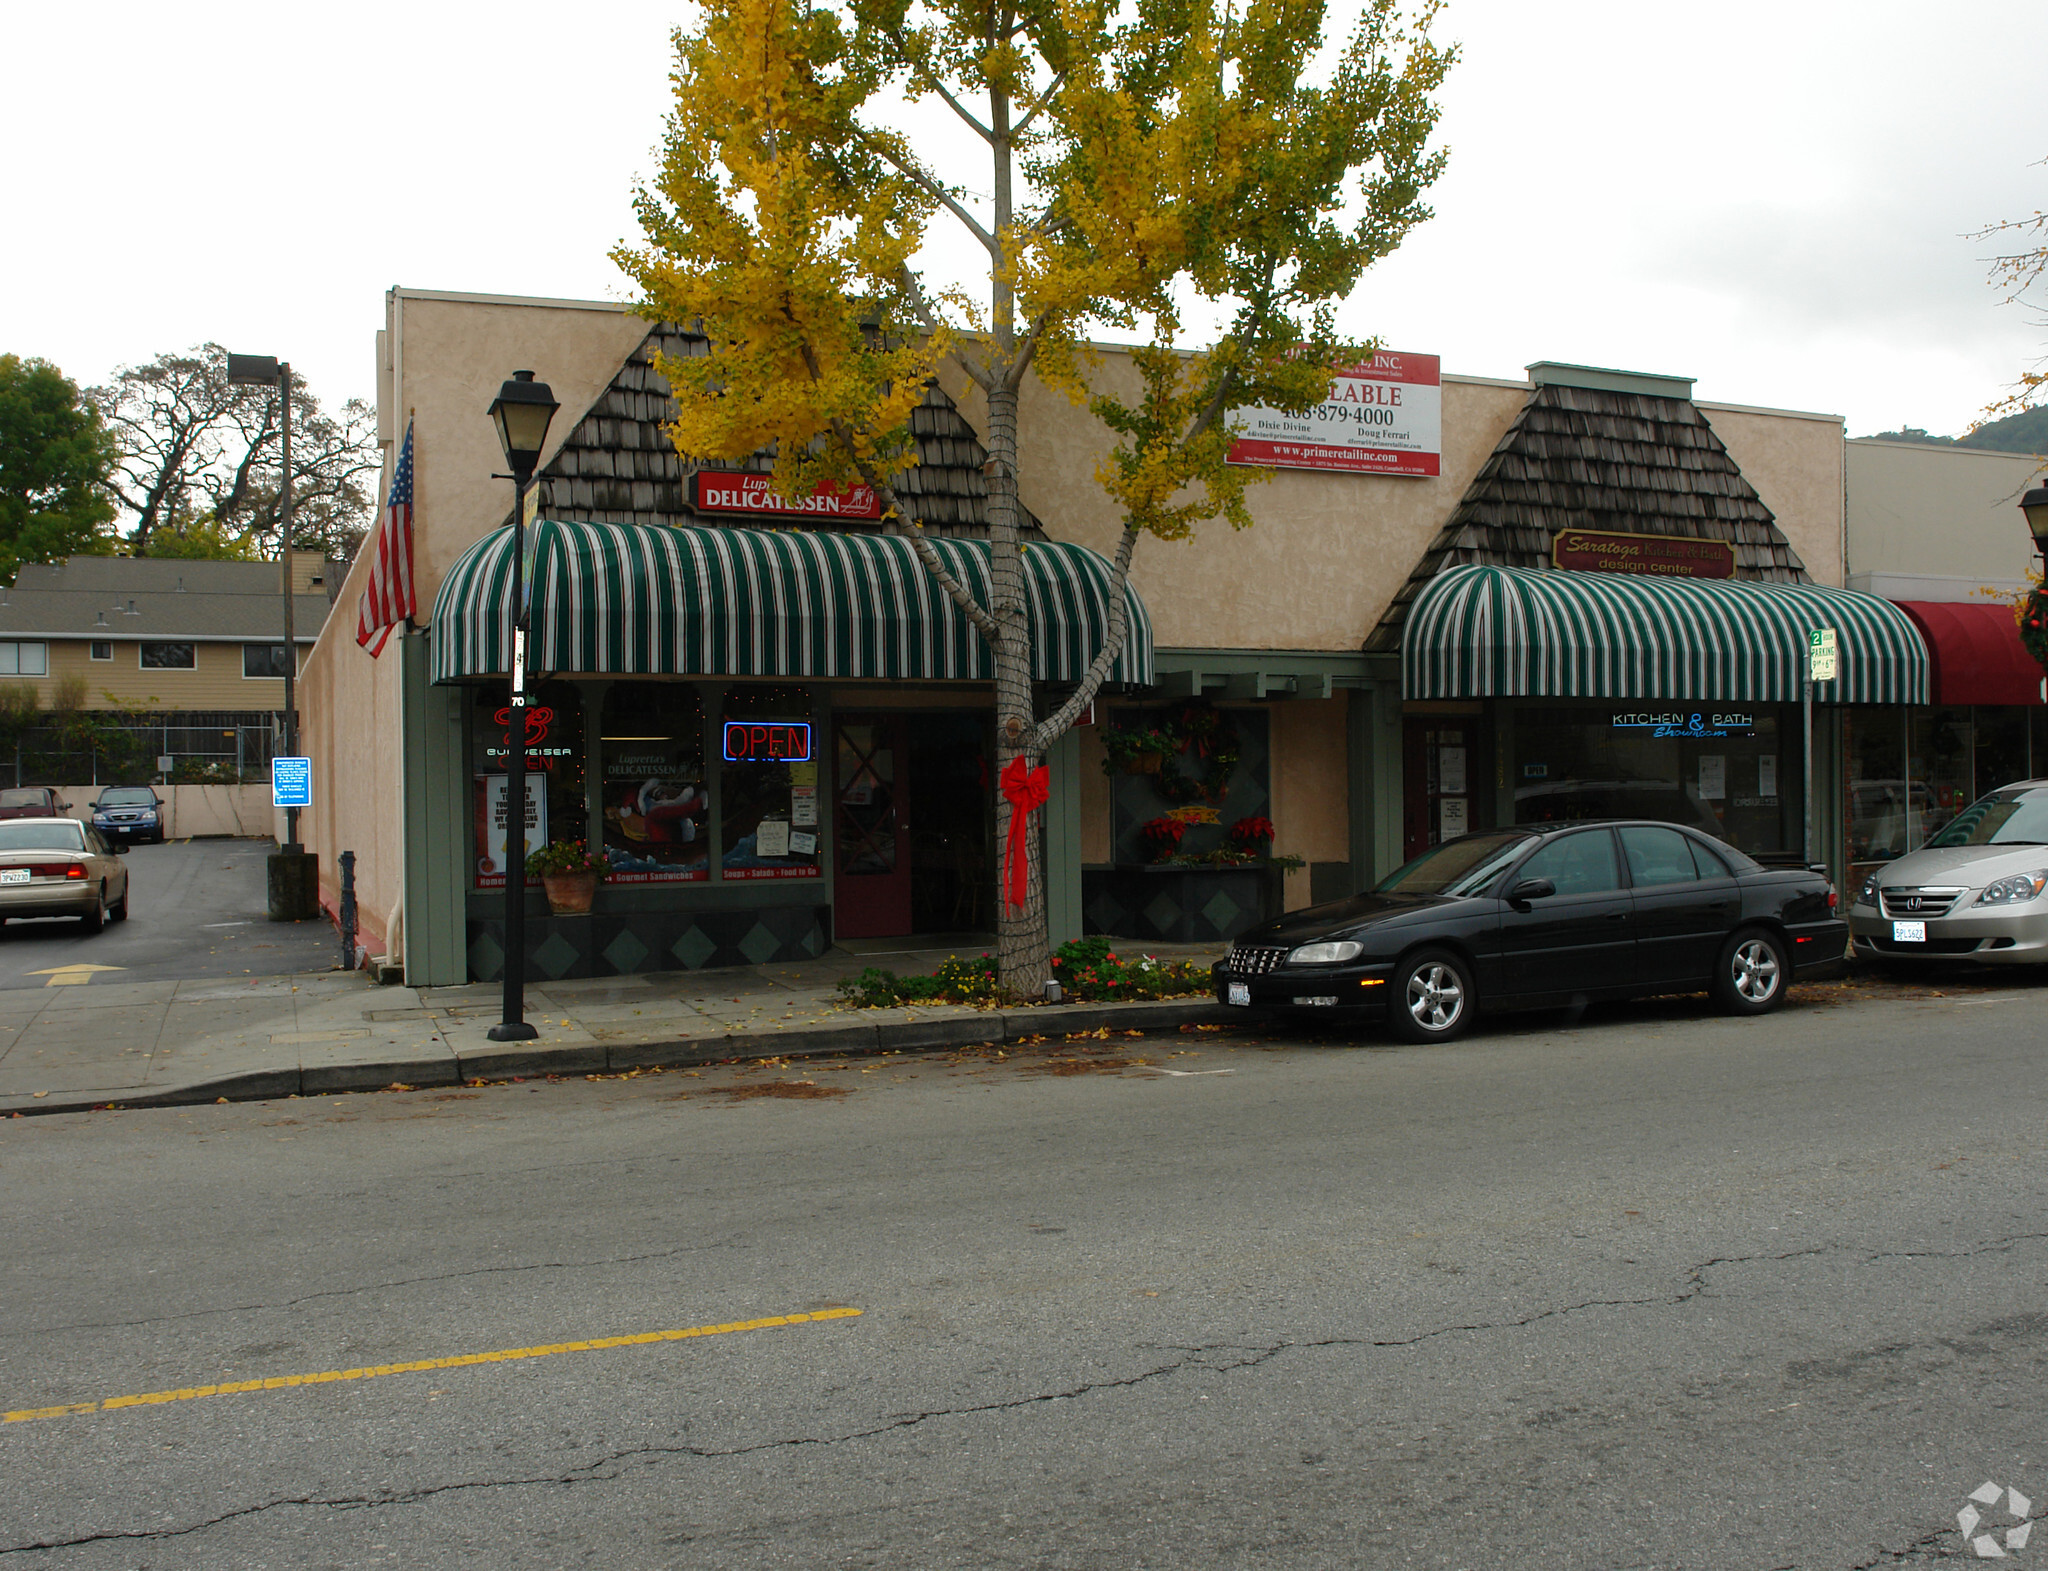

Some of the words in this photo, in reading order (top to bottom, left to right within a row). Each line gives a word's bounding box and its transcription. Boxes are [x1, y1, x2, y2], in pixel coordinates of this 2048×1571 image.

[1375, 355, 1402, 370] INC.
[1258, 420, 1280, 430] Dixie
[1283, 422, 1311, 432] Divine
[1358, 427, 1381, 440] Doug
[1382, 430, 1410, 440] Ferrari
[1273, 446, 1398, 463] www.primeretailinc.com
[1566, 536, 1641, 560] Saratoga
[1643, 542, 1683, 558] Kitchen
[1687, 544, 1698, 558] &
[1700, 546, 1725, 561] Bath
[1598, 558, 1646, 573] design
[1650, 562, 1694, 575] center
[1813, 633, 1820, 644] 2
[511, 696, 525, 707] 70
[1613, 713, 1684, 724] KITCHEN
[1689, 713, 1705, 731] &
[1712, 714, 1753, 725] BATH
[1653, 725, 1728, 738] Showroom
[727, 726, 808, 758] OPEN
[497, 754, 553, 770] OEN
[607, 764, 677, 776] DELICATESSEN
[1527, 766, 1544, 775] OPEN
[616, 873, 648, 882] Gourmet
[649, 872, 694, 881] Sandwiches
[724, 869, 746, 879] Soups
[752, 869, 774, 878] Salads
[781, 868, 797, 876] Food
[807, 867, 817, 875] Go
